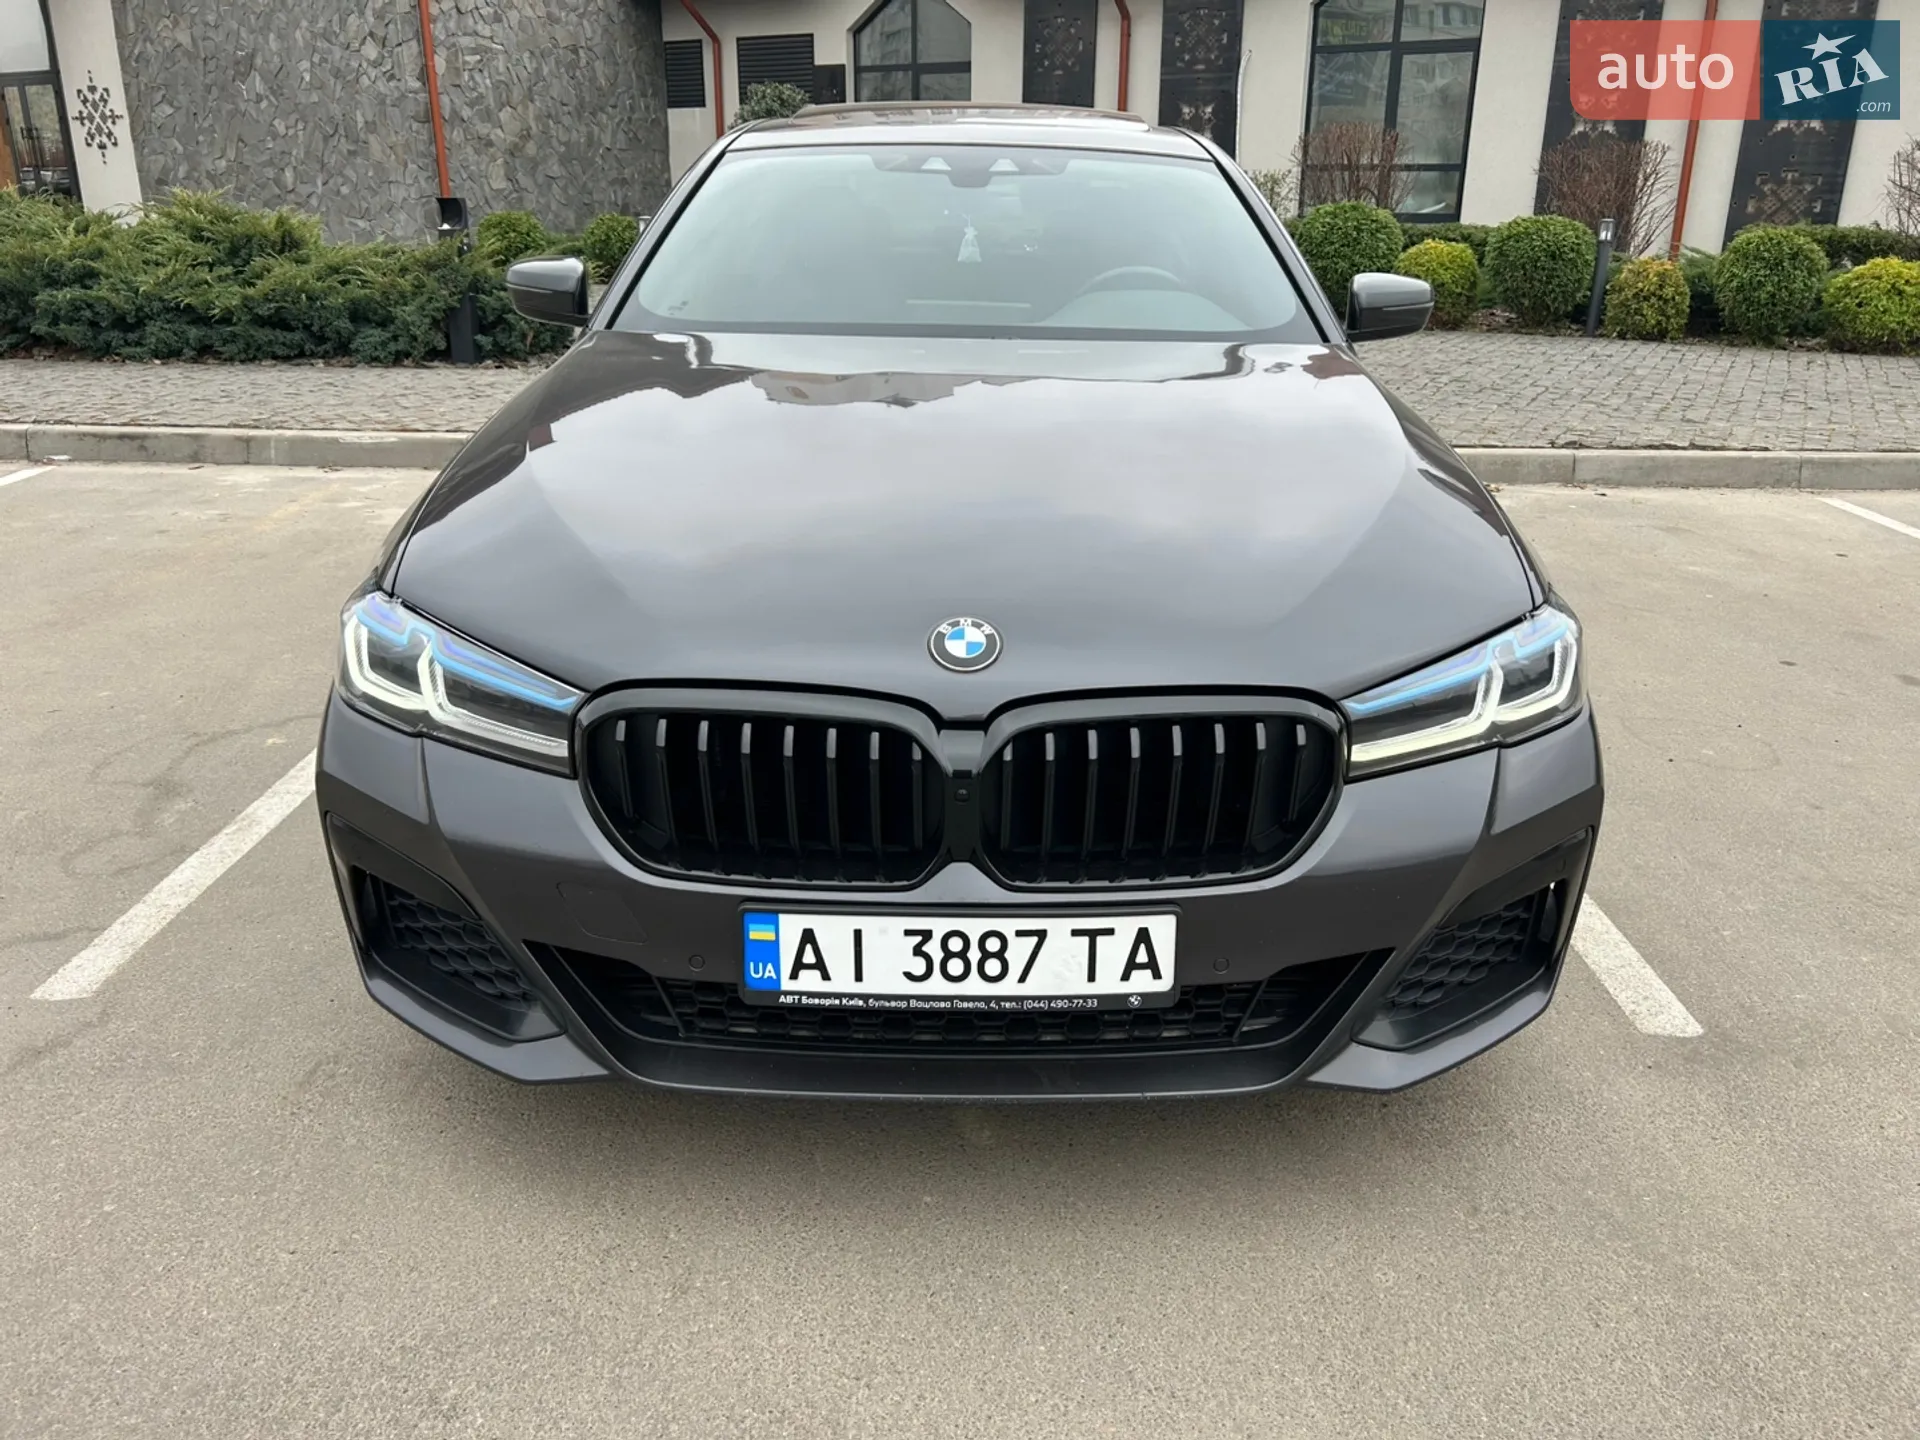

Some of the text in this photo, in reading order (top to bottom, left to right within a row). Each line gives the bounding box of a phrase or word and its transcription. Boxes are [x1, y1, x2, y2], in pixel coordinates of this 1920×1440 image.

[938, 618, 995, 635] BMW
[789, 927, 1163, 984] AI 3887 TA
[750, 961, 778, 980] UA
[778, 995, 801, 1004] АВТ
[868, 998, 908, 1009] бульвар
[1023, 999, 1049, 1010] (044)
[1050, 998, 1098, 1008] 490-77-33
